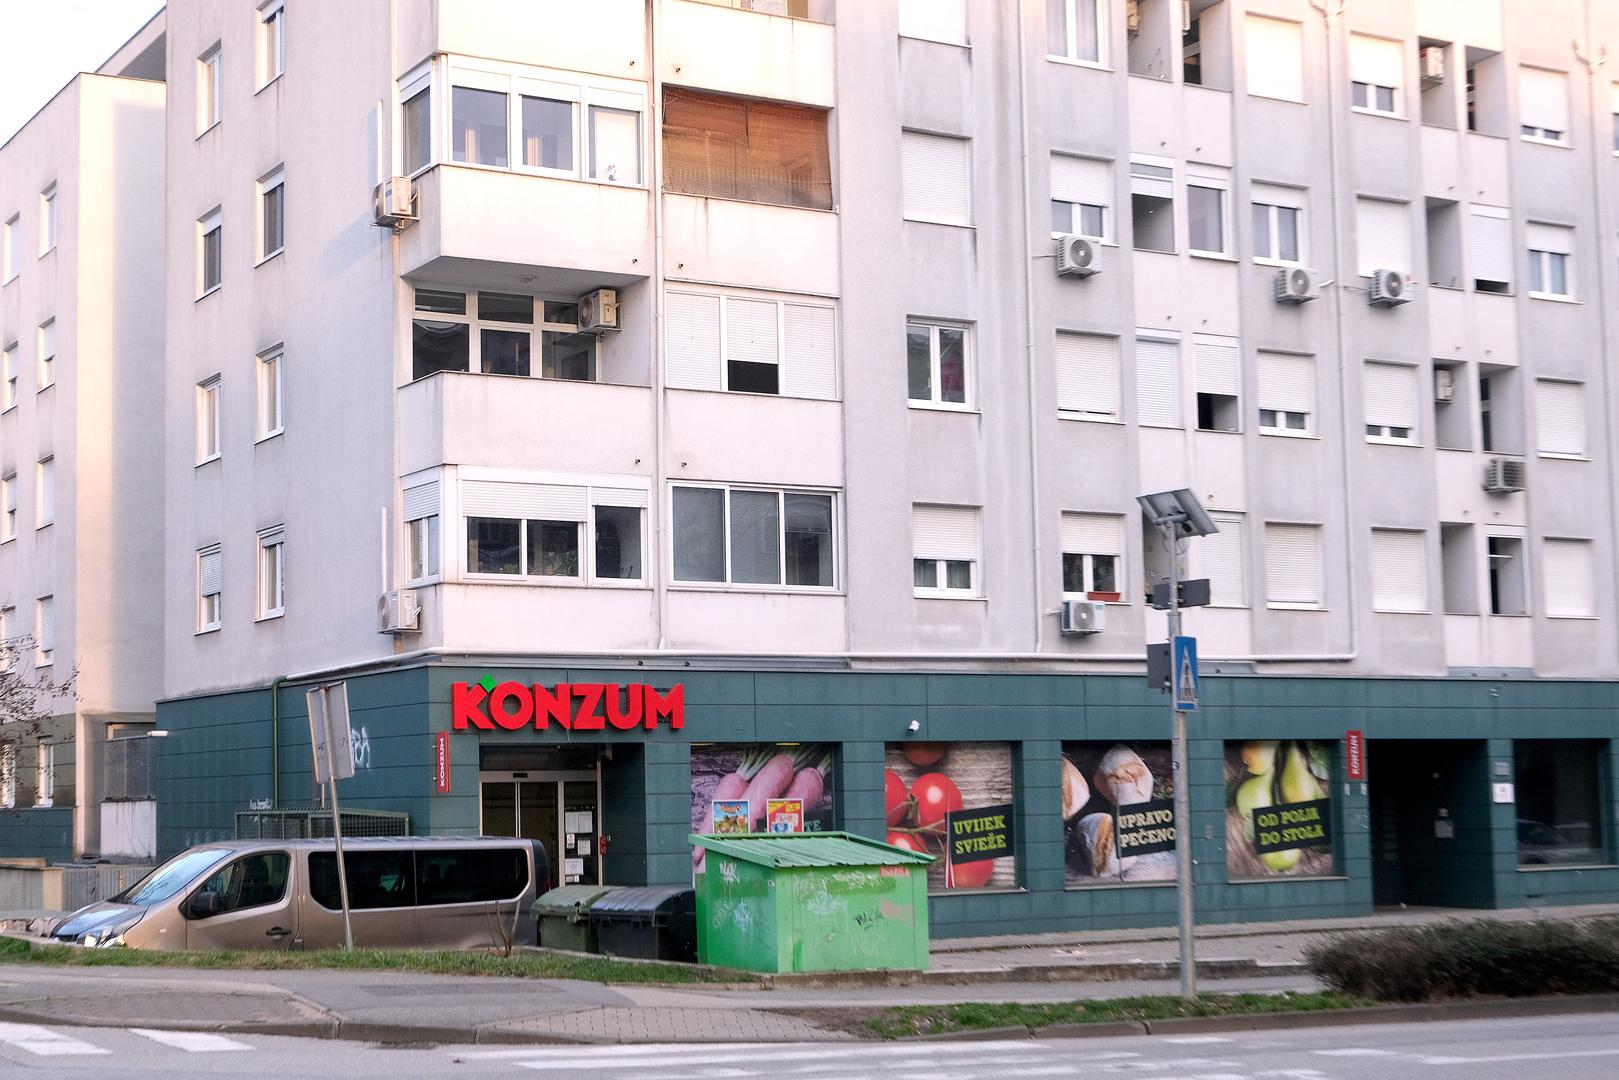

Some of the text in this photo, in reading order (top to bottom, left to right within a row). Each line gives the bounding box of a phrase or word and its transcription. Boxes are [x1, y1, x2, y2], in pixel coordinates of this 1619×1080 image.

[452, 680, 685, 730] KONZUM
[1350, 735, 1361, 774] KONZUM
[953, 815, 1006, 835] UVIJEK
[1118, 809, 1173, 829] UPRAVO
[1258, 813, 1279, 828] OD
[955, 832, 1007, 854] SVJEŽE
[1120, 827, 1177, 848] PEČENO
[1259, 824, 1324, 845] DO STOLA
